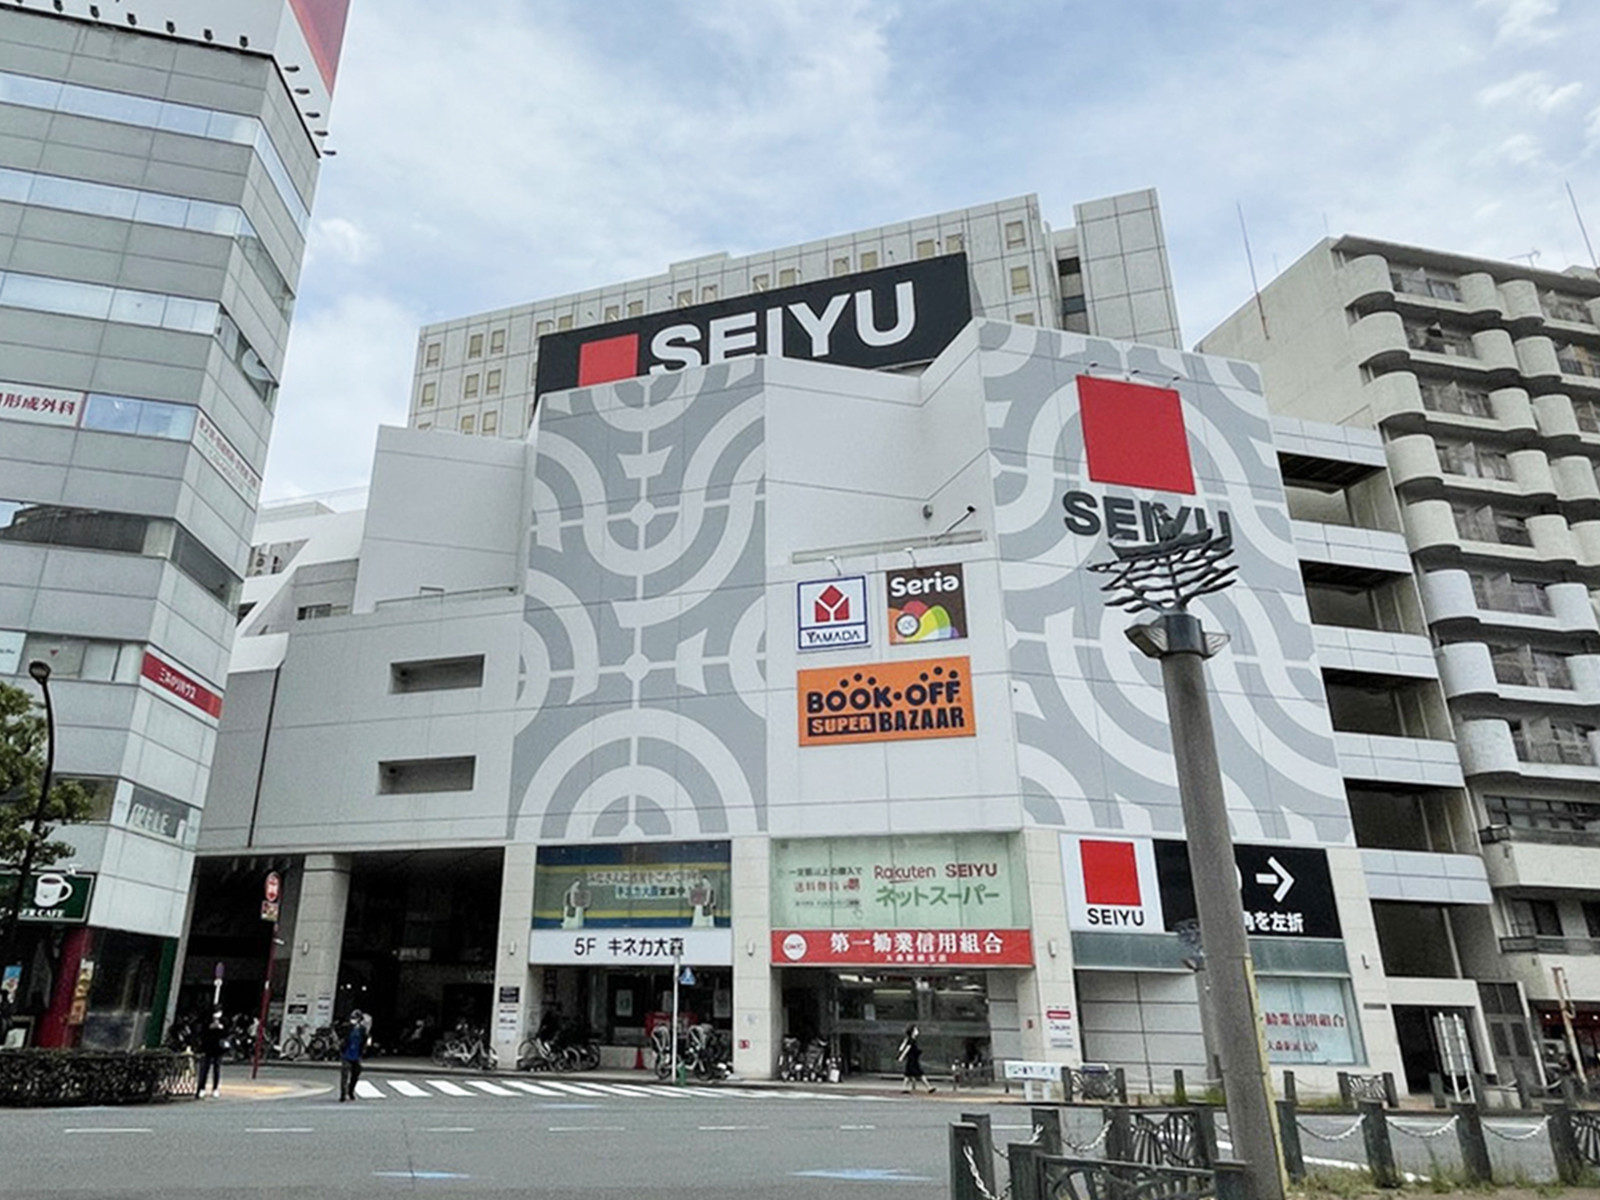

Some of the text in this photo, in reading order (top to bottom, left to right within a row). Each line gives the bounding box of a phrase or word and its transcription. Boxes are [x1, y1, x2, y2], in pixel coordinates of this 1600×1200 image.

[649, 281, 916, 376] SEIYU
[0, 393, 75, 416] 形成外科
[1062, 490, 1232, 552] SEIYU
[890, 571, 959, 597] Seria
[807, 630, 860, 644] YAMADA
[811, 706, 965, 733] SUPER BAZAAR
[874, 864, 997, 880] Rakuten SEIYU
[876, 884, 999, 908] ネットスーパー
[1087, 908, 1144, 926] SEIYU
[574, 937, 685, 956] 5F キネカ大森
